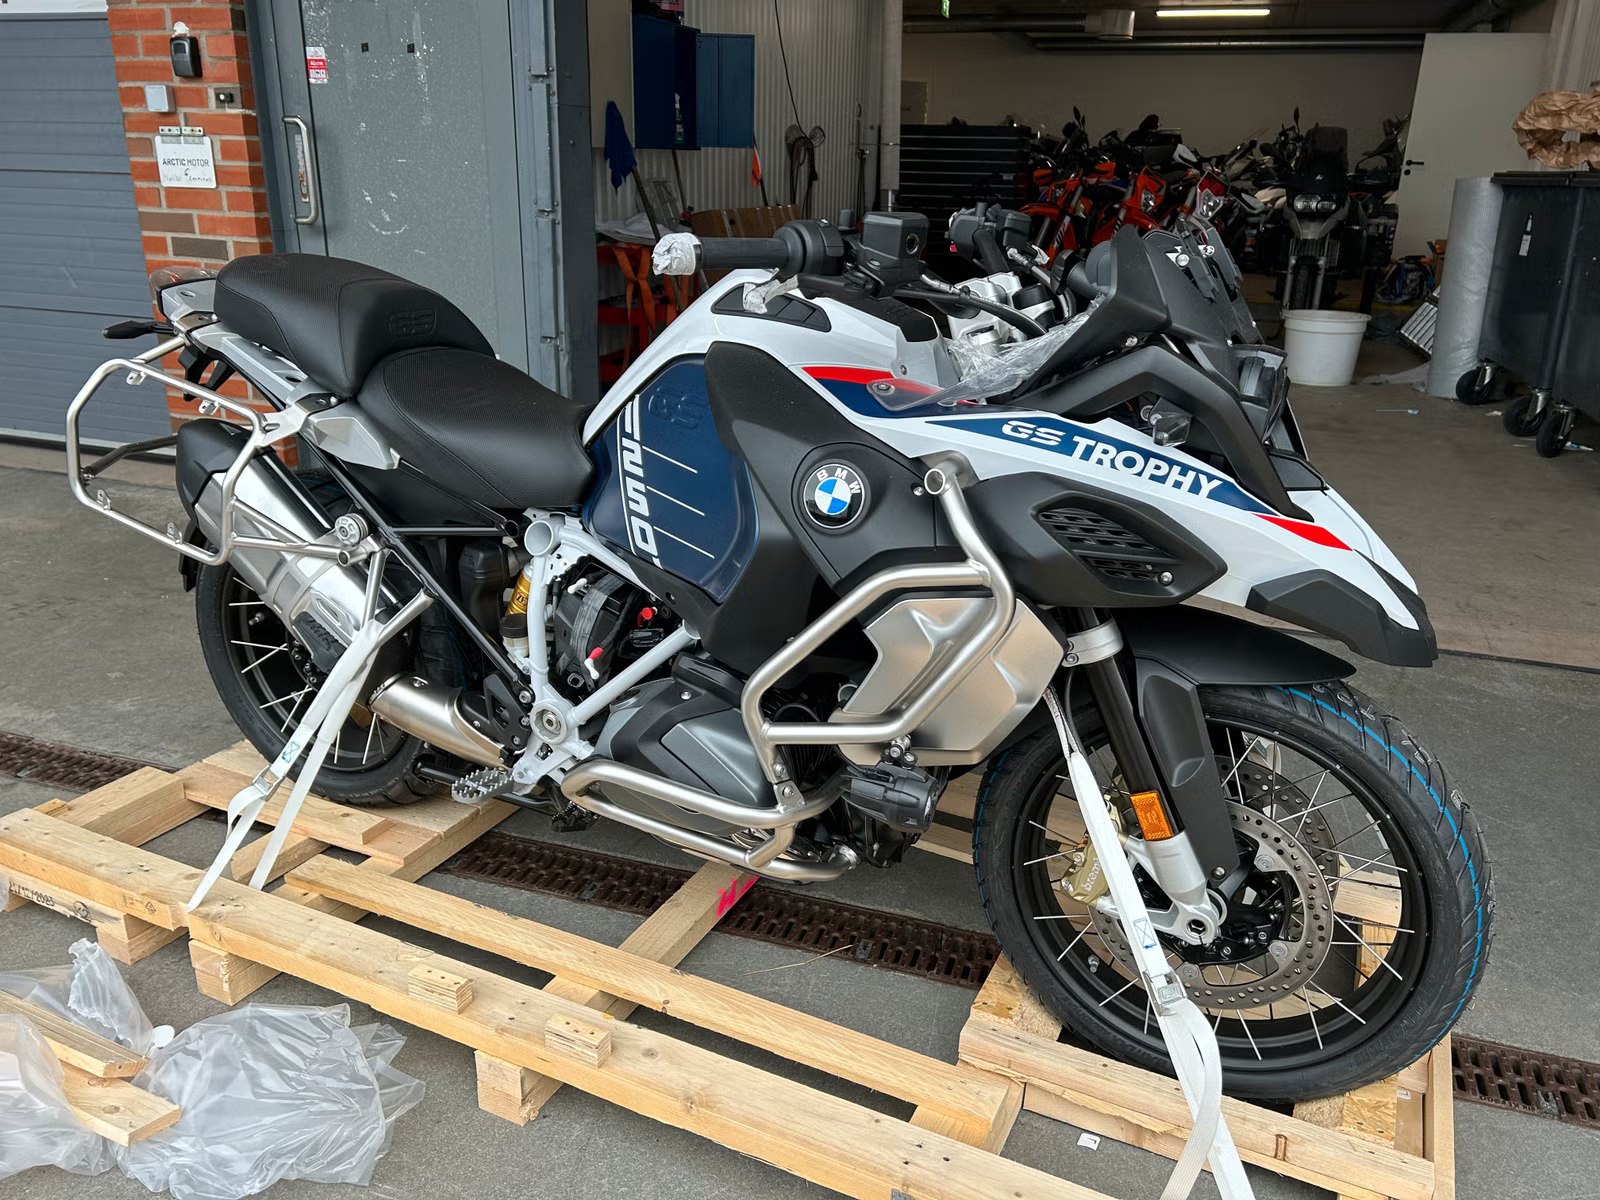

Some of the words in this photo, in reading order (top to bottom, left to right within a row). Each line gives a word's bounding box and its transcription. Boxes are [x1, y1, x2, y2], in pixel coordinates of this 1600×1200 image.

[162, 157, 186, 166] ARCTIC
[186, 158, 209, 167] MOTOR
[1001, 420, 1066, 446] GS
[1071, 435, 1223, 498] TROPHY
[816, 467, 861, 494] BMW
[1081, 857, 1101, 892] brem
